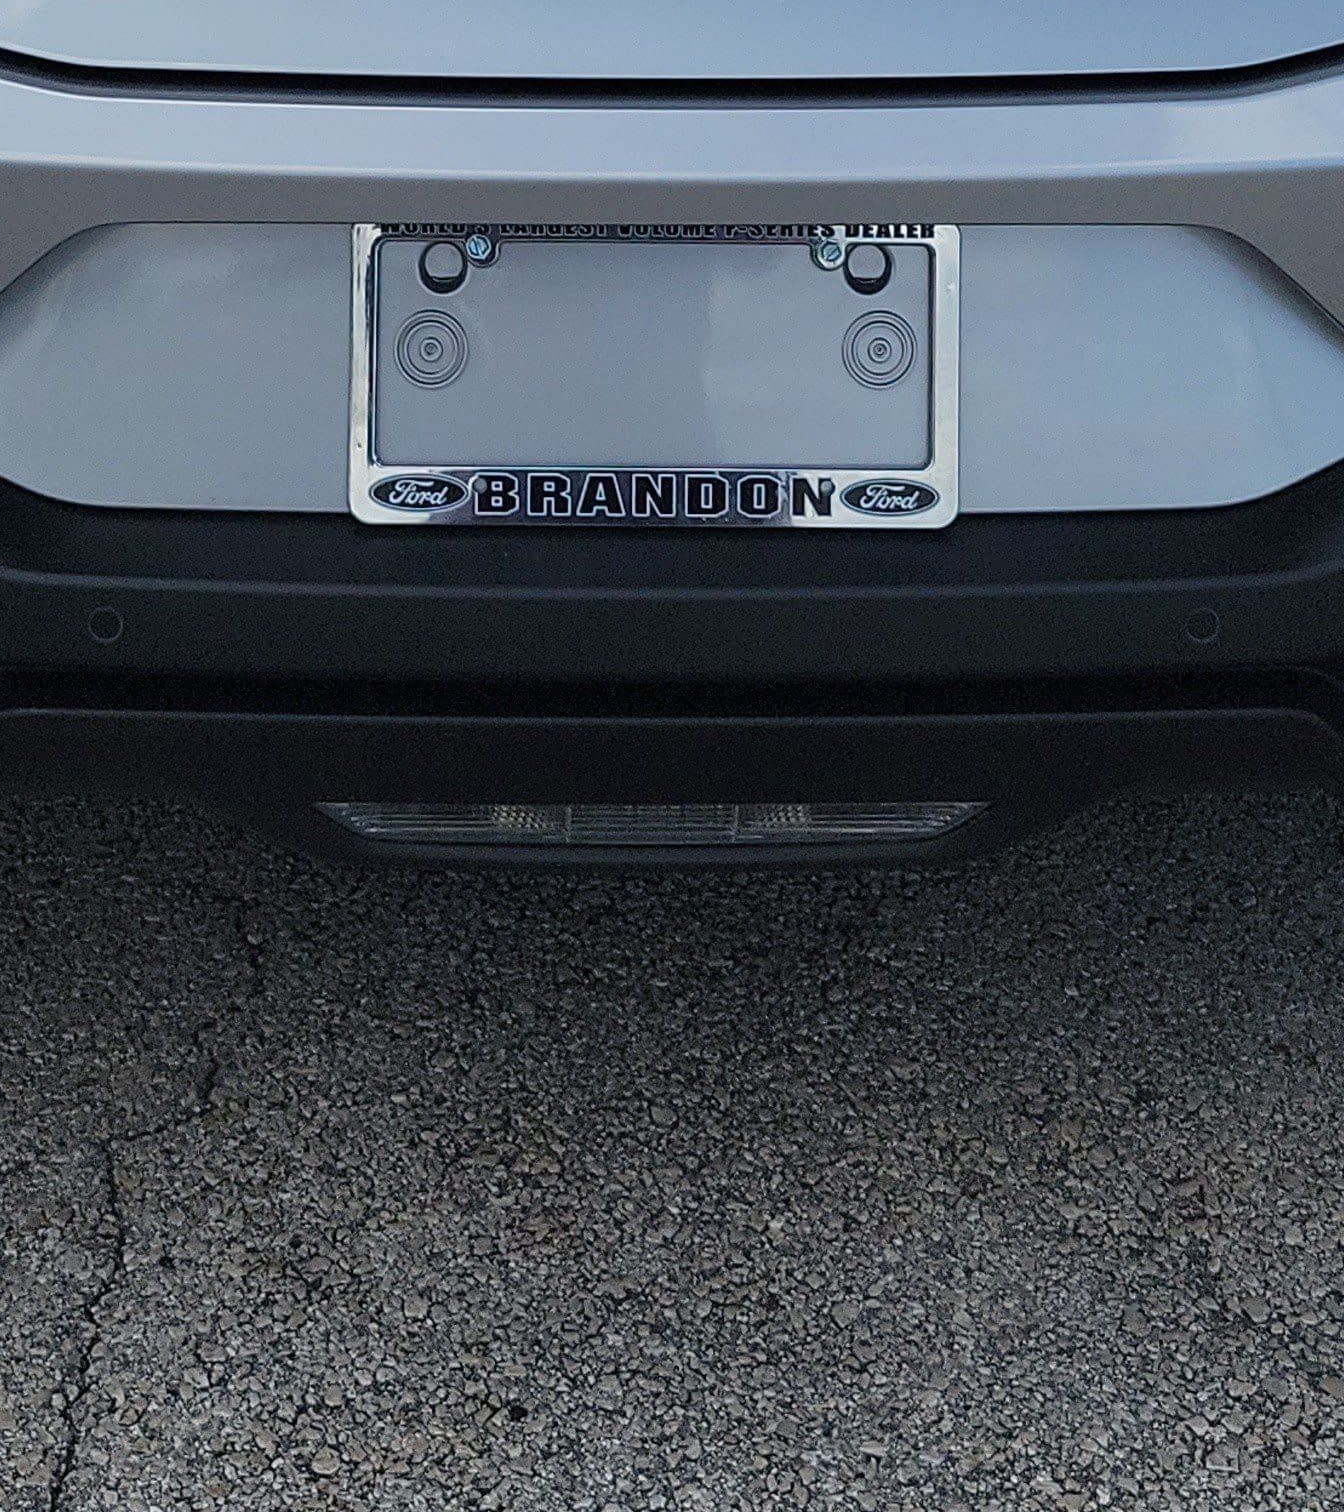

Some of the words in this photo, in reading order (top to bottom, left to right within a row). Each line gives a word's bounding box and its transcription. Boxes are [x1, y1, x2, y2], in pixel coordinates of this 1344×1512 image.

[381, 223, 490, 235] WORLDS
[499, 224, 607, 236] LARGEST
[617, 224, 717, 237] VOLUME
[844, 224, 935, 238] DEALER
[389, 479, 448, 505] Ford
[472, 473, 834, 518] BRANDON
[859, 483, 920, 509] Ford
